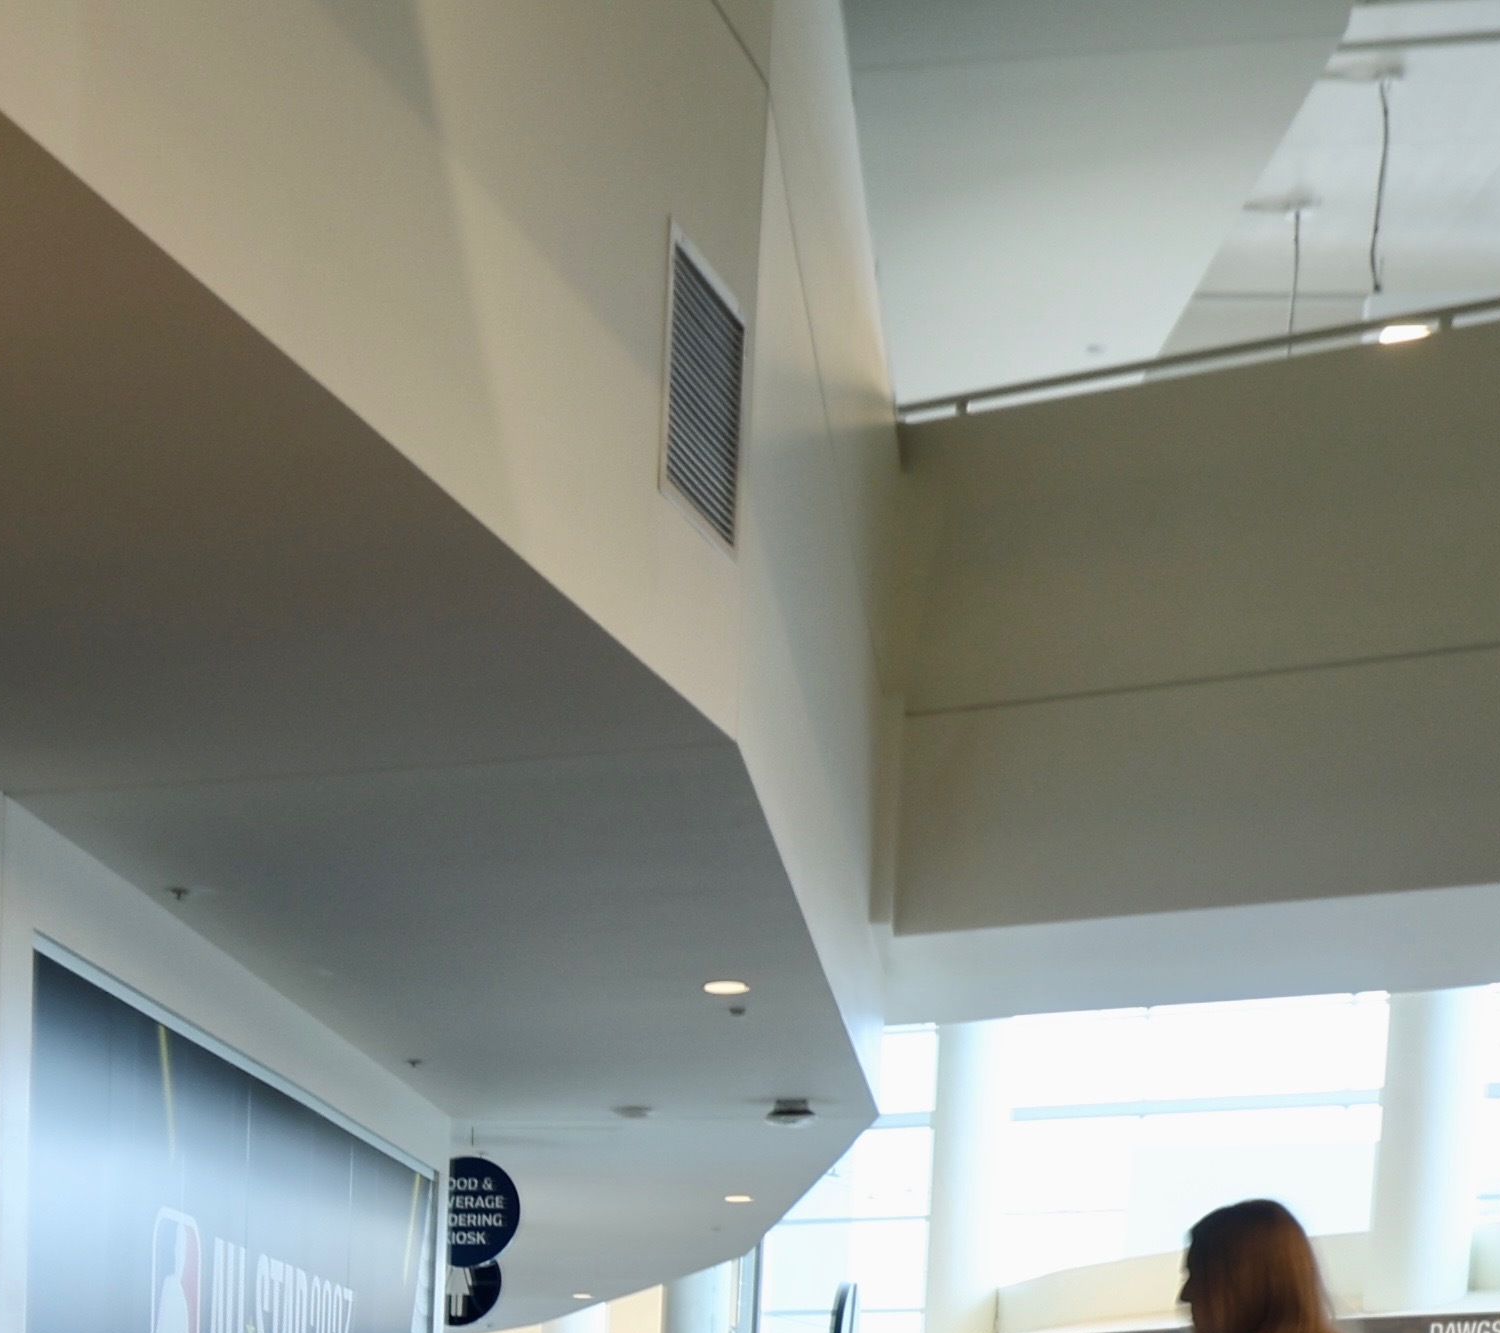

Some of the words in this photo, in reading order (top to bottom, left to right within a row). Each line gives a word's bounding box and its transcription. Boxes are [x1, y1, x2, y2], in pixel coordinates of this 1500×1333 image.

[449, 1177, 478, 1190] OOD
[483, 1177, 493, 1191] &
[448, 1195, 504, 1209] VERAGE
[448, 1213, 503, 1227] DERING
[447, 1231, 487, 1245] IOSK
